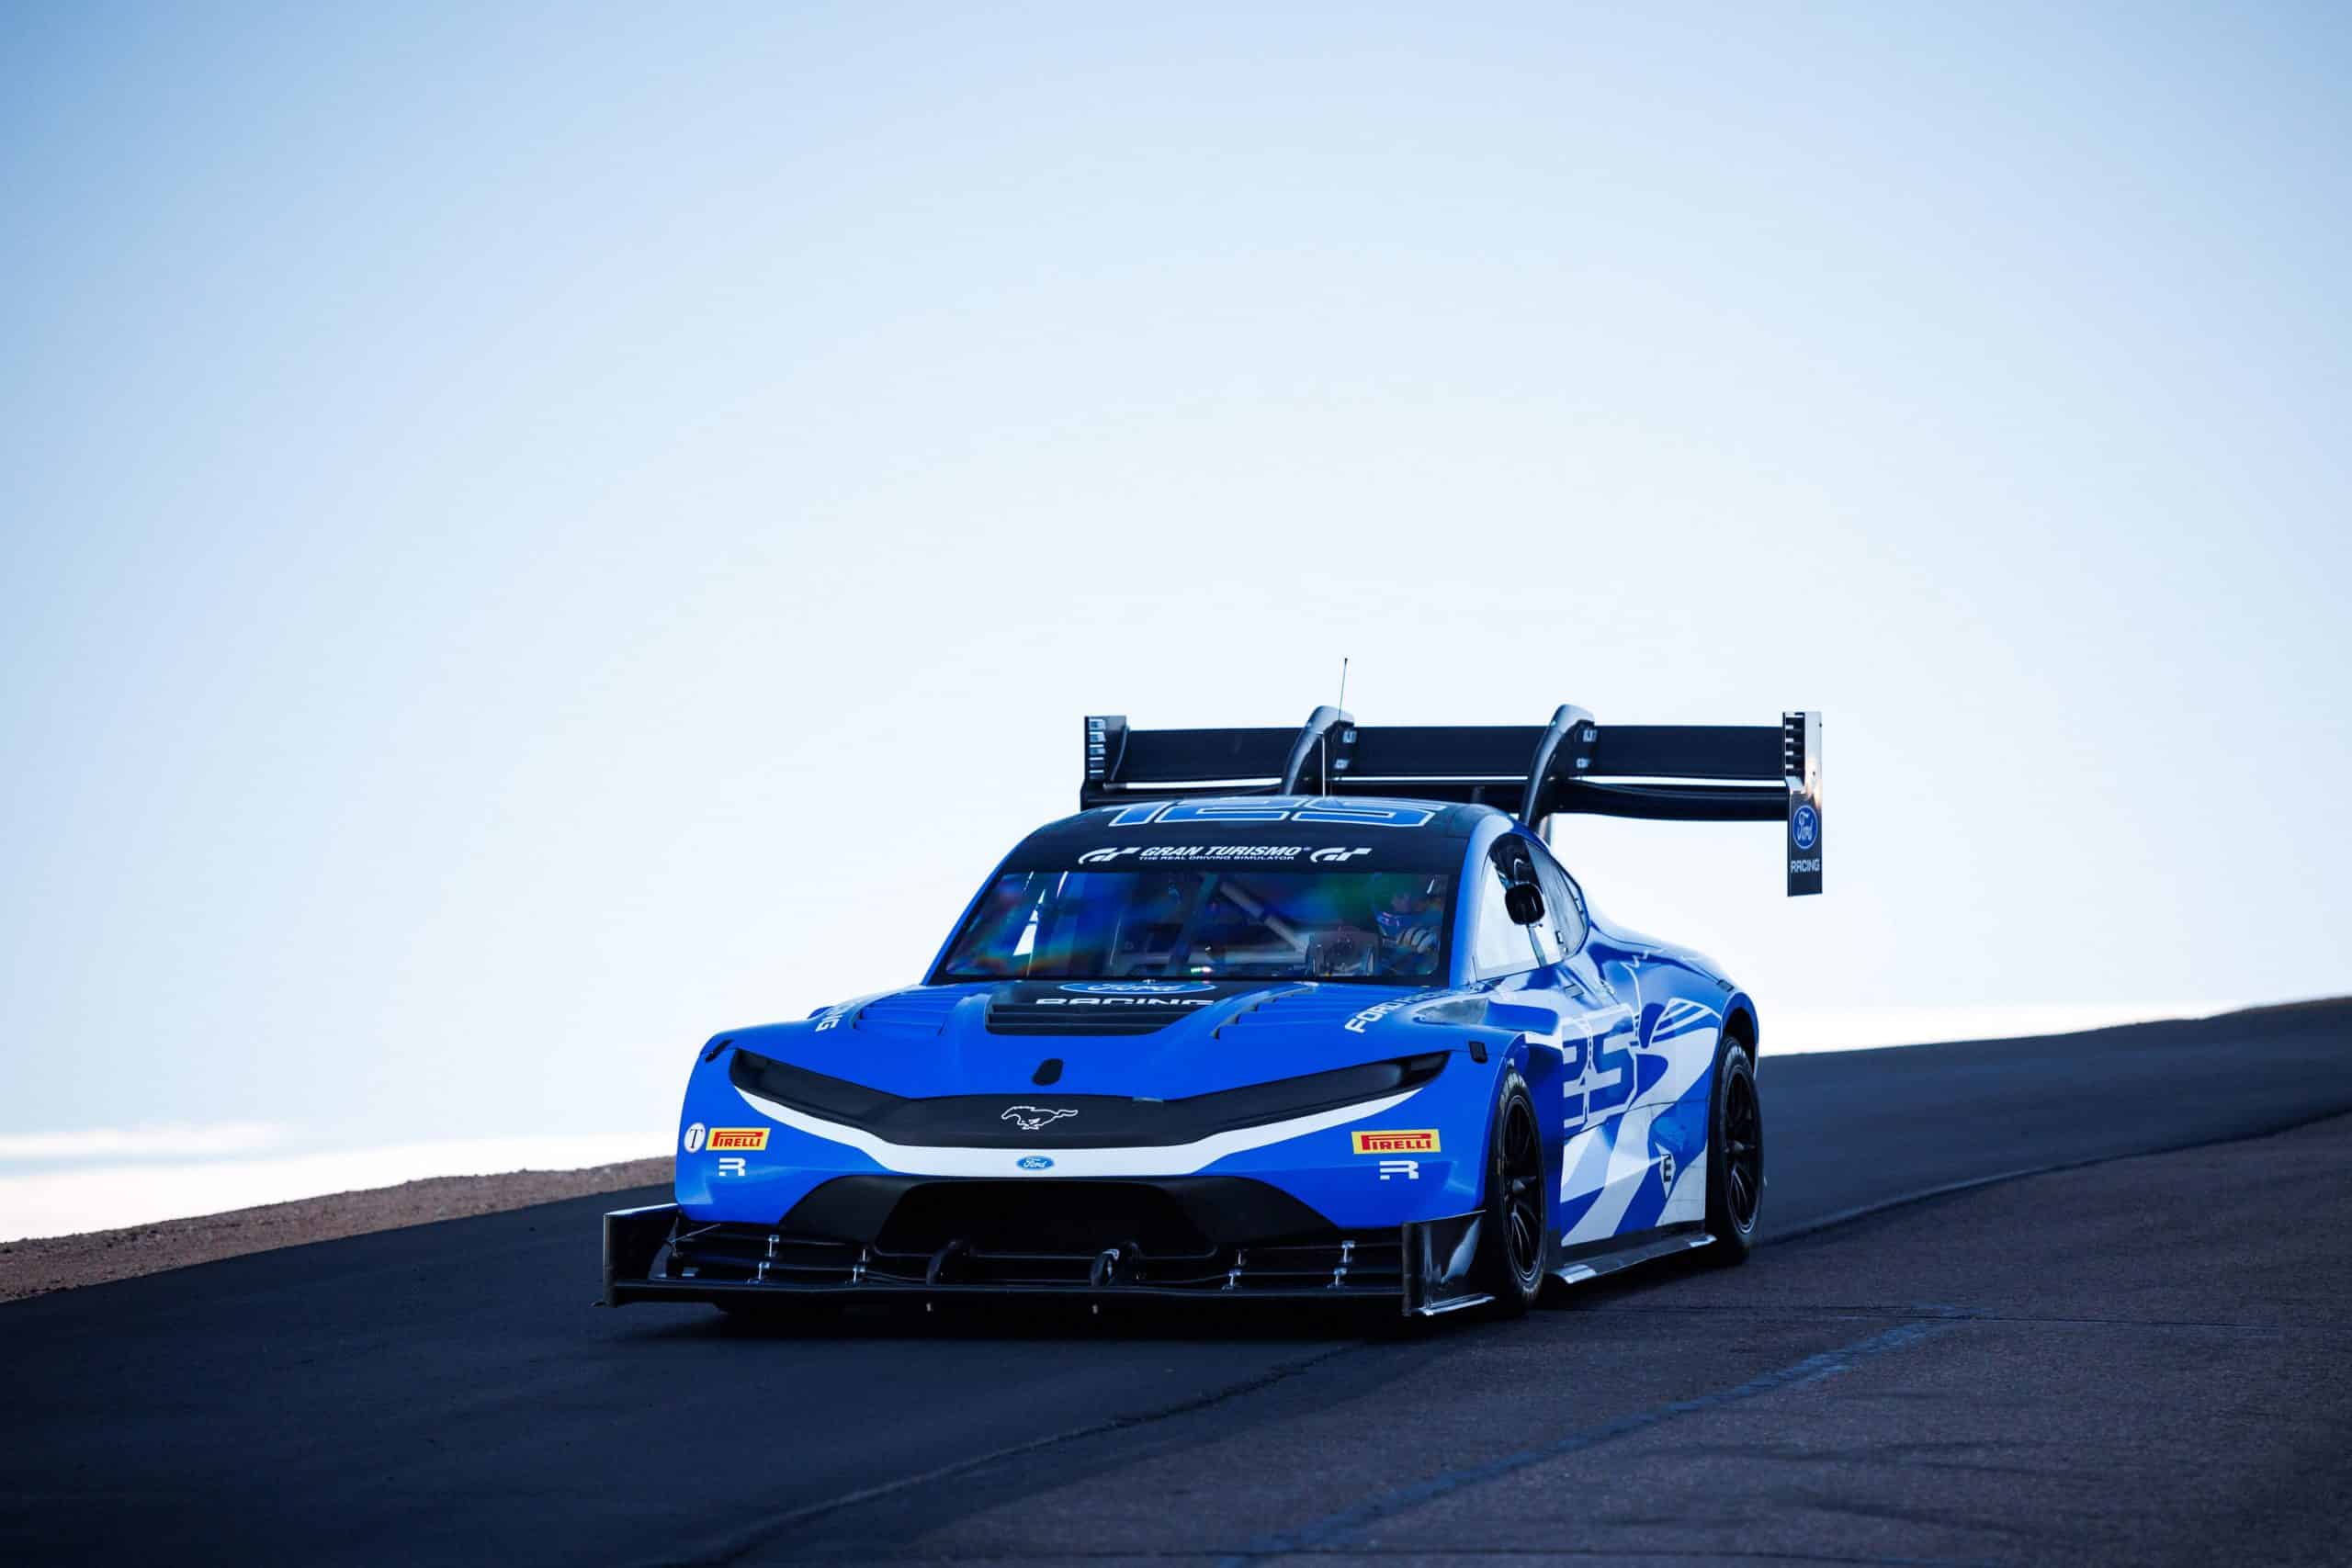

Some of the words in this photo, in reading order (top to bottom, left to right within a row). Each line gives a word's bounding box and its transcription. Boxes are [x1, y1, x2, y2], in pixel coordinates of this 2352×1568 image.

[1140, 846, 1204, 856] GRAN
[1790, 859, 1820, 874] RACING
[1344, 1001, 1403, 1033] FORD
[712, 1131, 763, 1147] PIRELLI
[1361, 1133, 1431, 1151] PIRELLI
